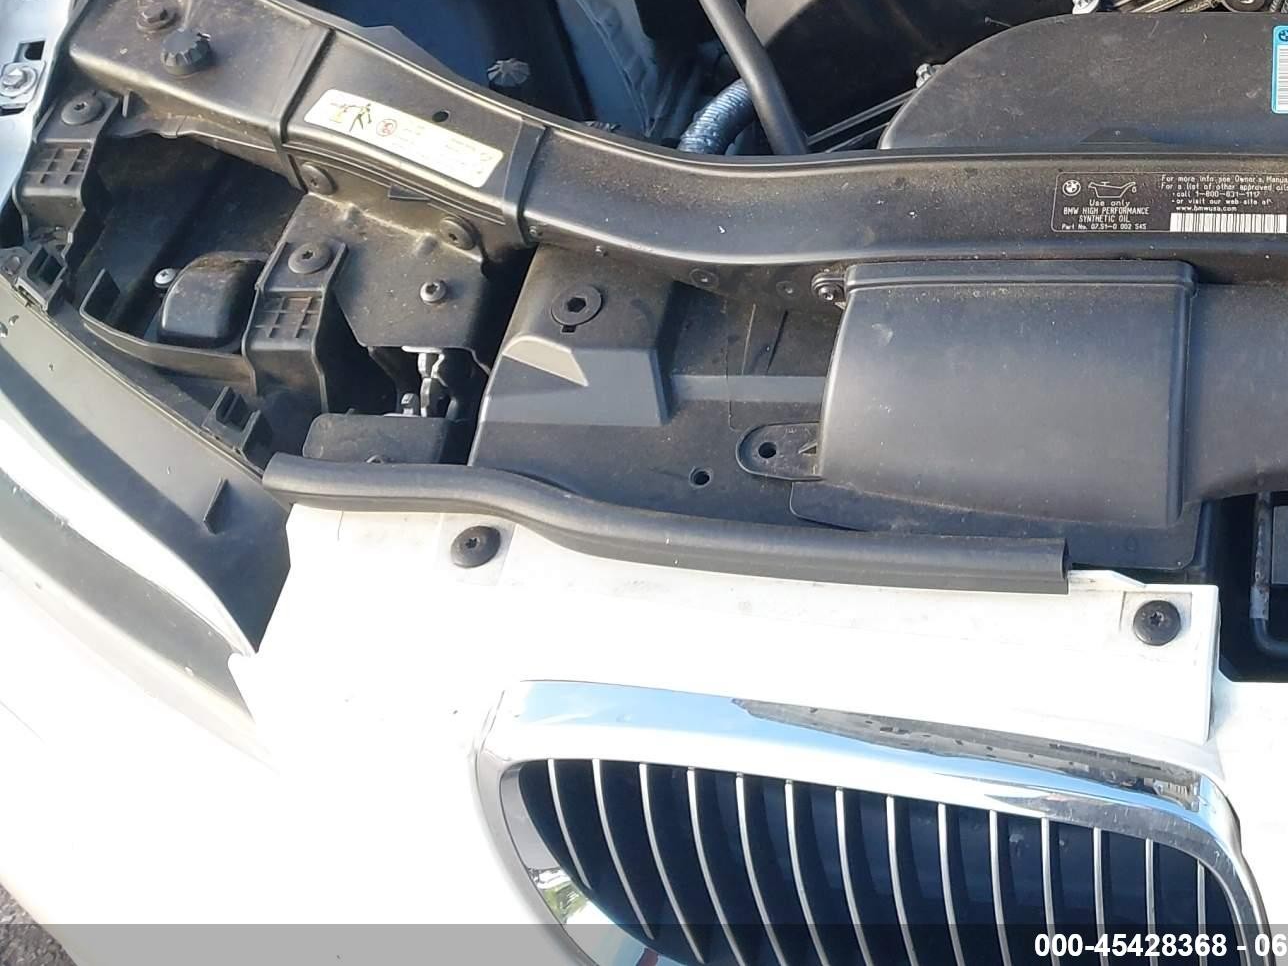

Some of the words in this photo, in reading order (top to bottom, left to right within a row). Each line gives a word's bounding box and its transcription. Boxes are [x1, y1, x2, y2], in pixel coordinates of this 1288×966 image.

[1161, 175, 1174, 183] For
[1240, 183, 1272, 191] approved
[1089, 199, 1105, 207] Use
[1111, 199, 1130, 208] only
[1188, 197, 1205, 205] visit
[1063, 207, 1079, 215] BMW
[1082, 207, 1098, 215] HIGH
[1102, 207, 1150, 215] PERFORMANCE
[1079, 215, 1116, 223] SYNTHETIC
